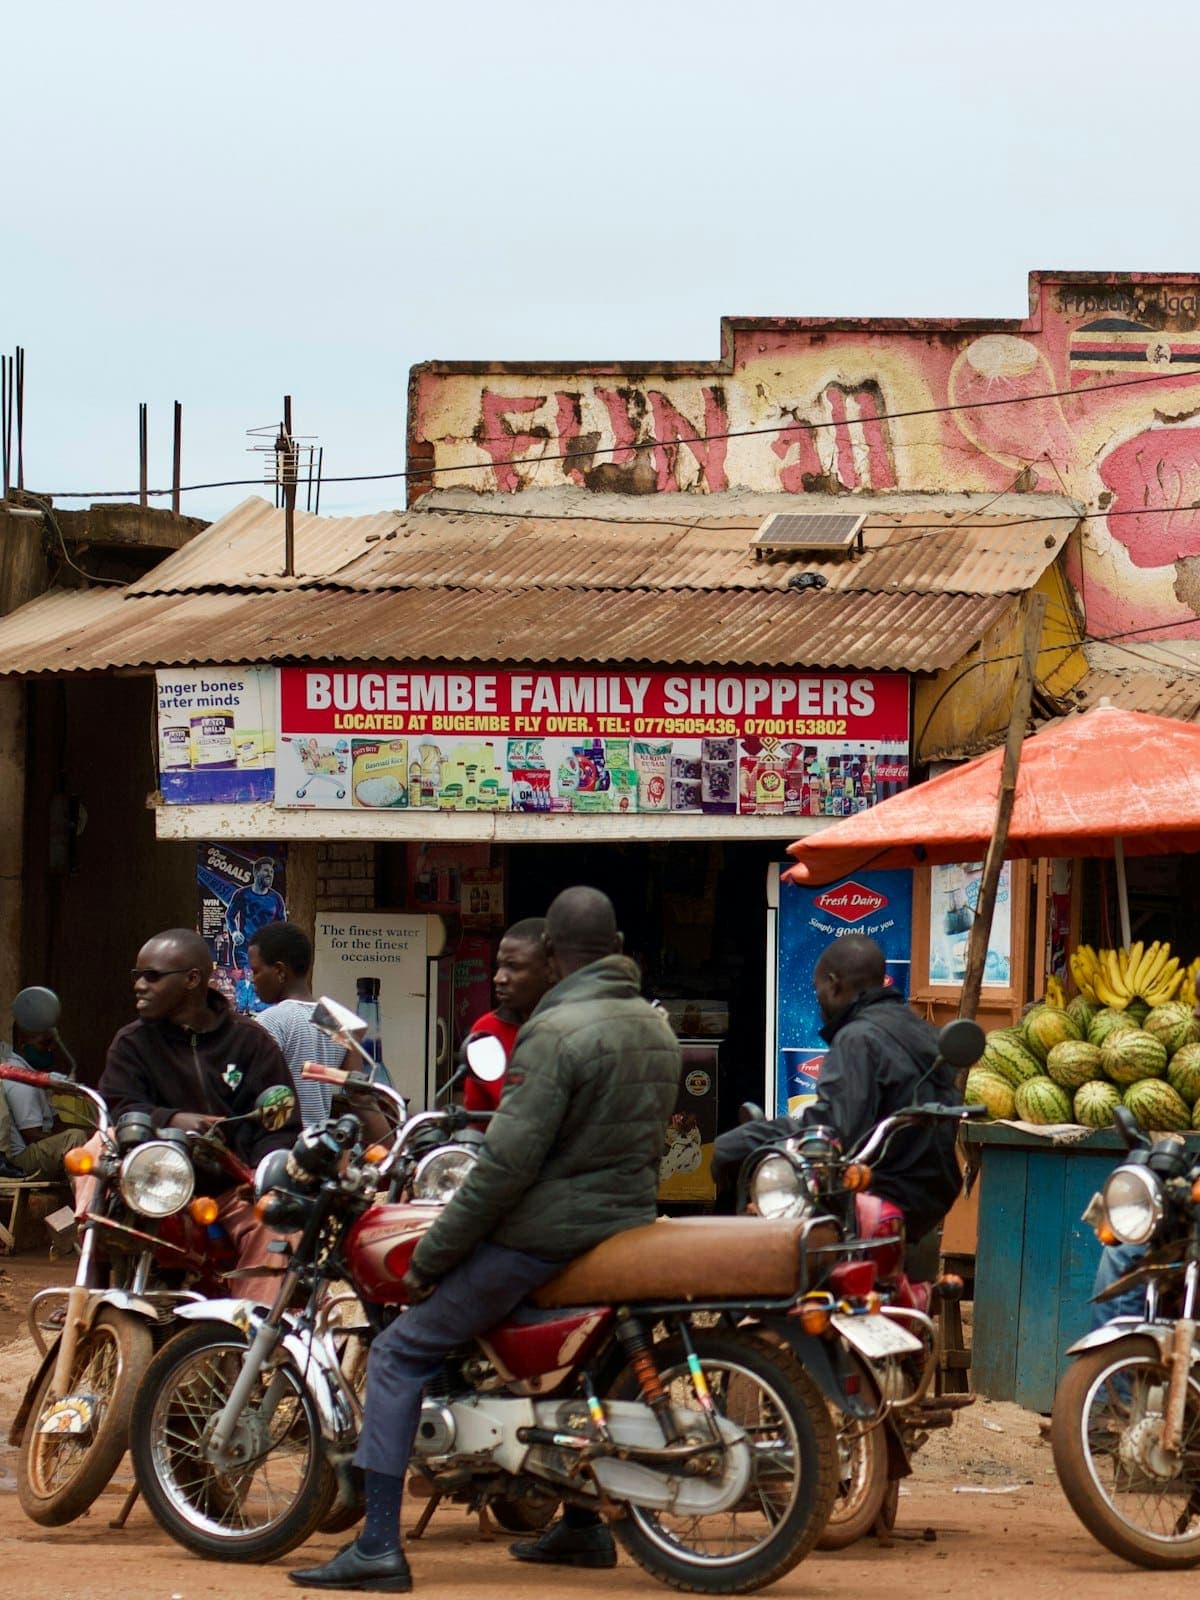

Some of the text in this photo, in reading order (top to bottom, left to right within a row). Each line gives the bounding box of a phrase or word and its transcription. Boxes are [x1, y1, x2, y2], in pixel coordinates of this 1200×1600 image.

[200, 680, 244, 692] bones
[196, 693, 241, 707] minds
[306, 673, 876, 717] BUGEMBE FAMILY SHOPPERS
[334, 713, 847, 737] LOCATED AT BUGEMBE FLY OVER. TEL: 0779505436, 0700153802
[207, 856, 252, 883] GOOAALS
[820, 894, 882, 909] Fresh Dairy
[320, 924, 420, 937] The finest water
[808, 918, 895, 938] Simply good for you
[331, 938, 409, 950] for the finest
[341, 951, 401, 963] occasions
